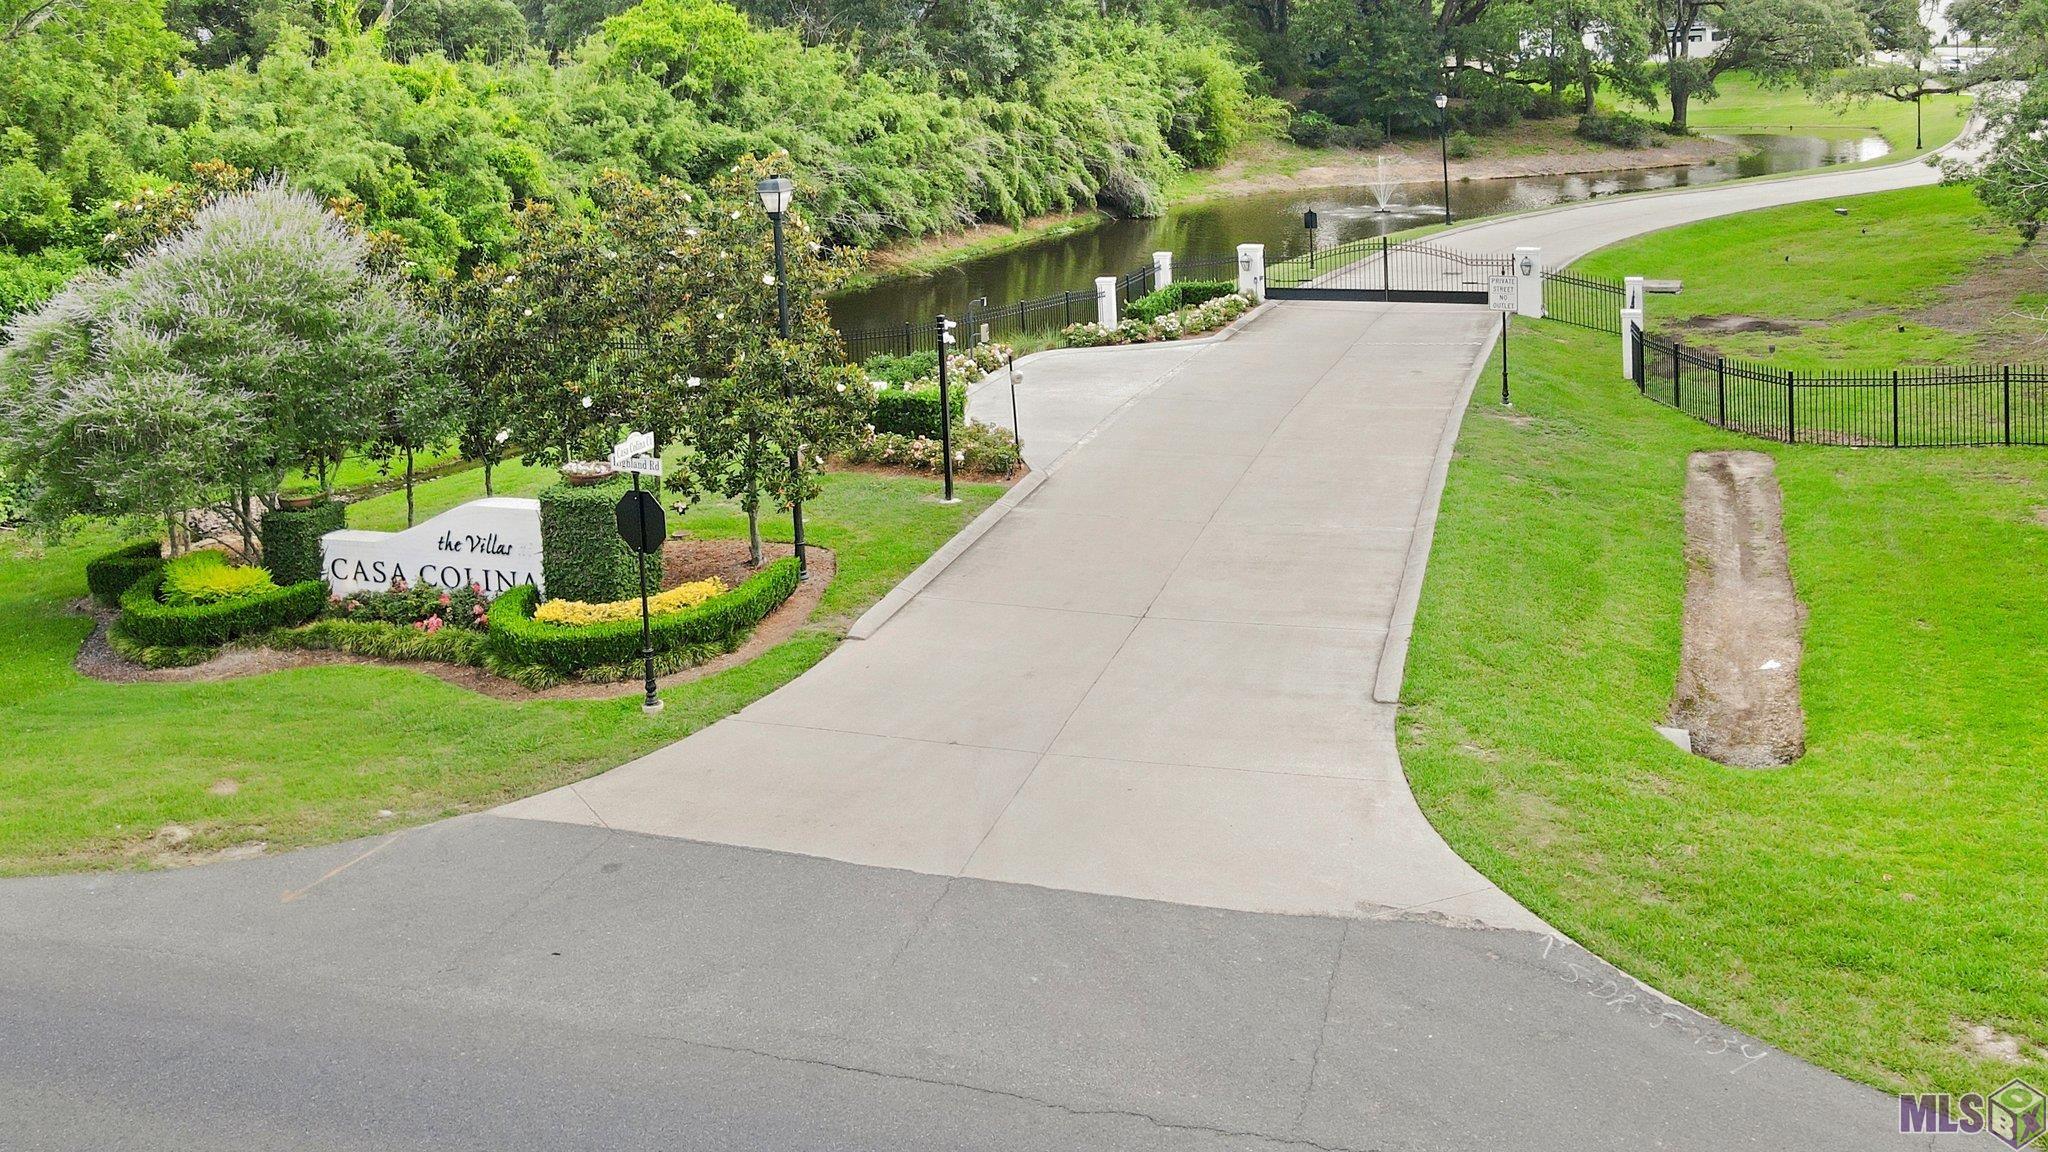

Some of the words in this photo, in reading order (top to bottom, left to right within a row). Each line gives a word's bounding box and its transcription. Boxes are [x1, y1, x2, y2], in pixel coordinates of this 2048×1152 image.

[650, 460, 660, 470] Rd
[438, 530, 462, 552] the
[465, 533, 513, 557] Villas
[331, 557, 406, 584] CASA
